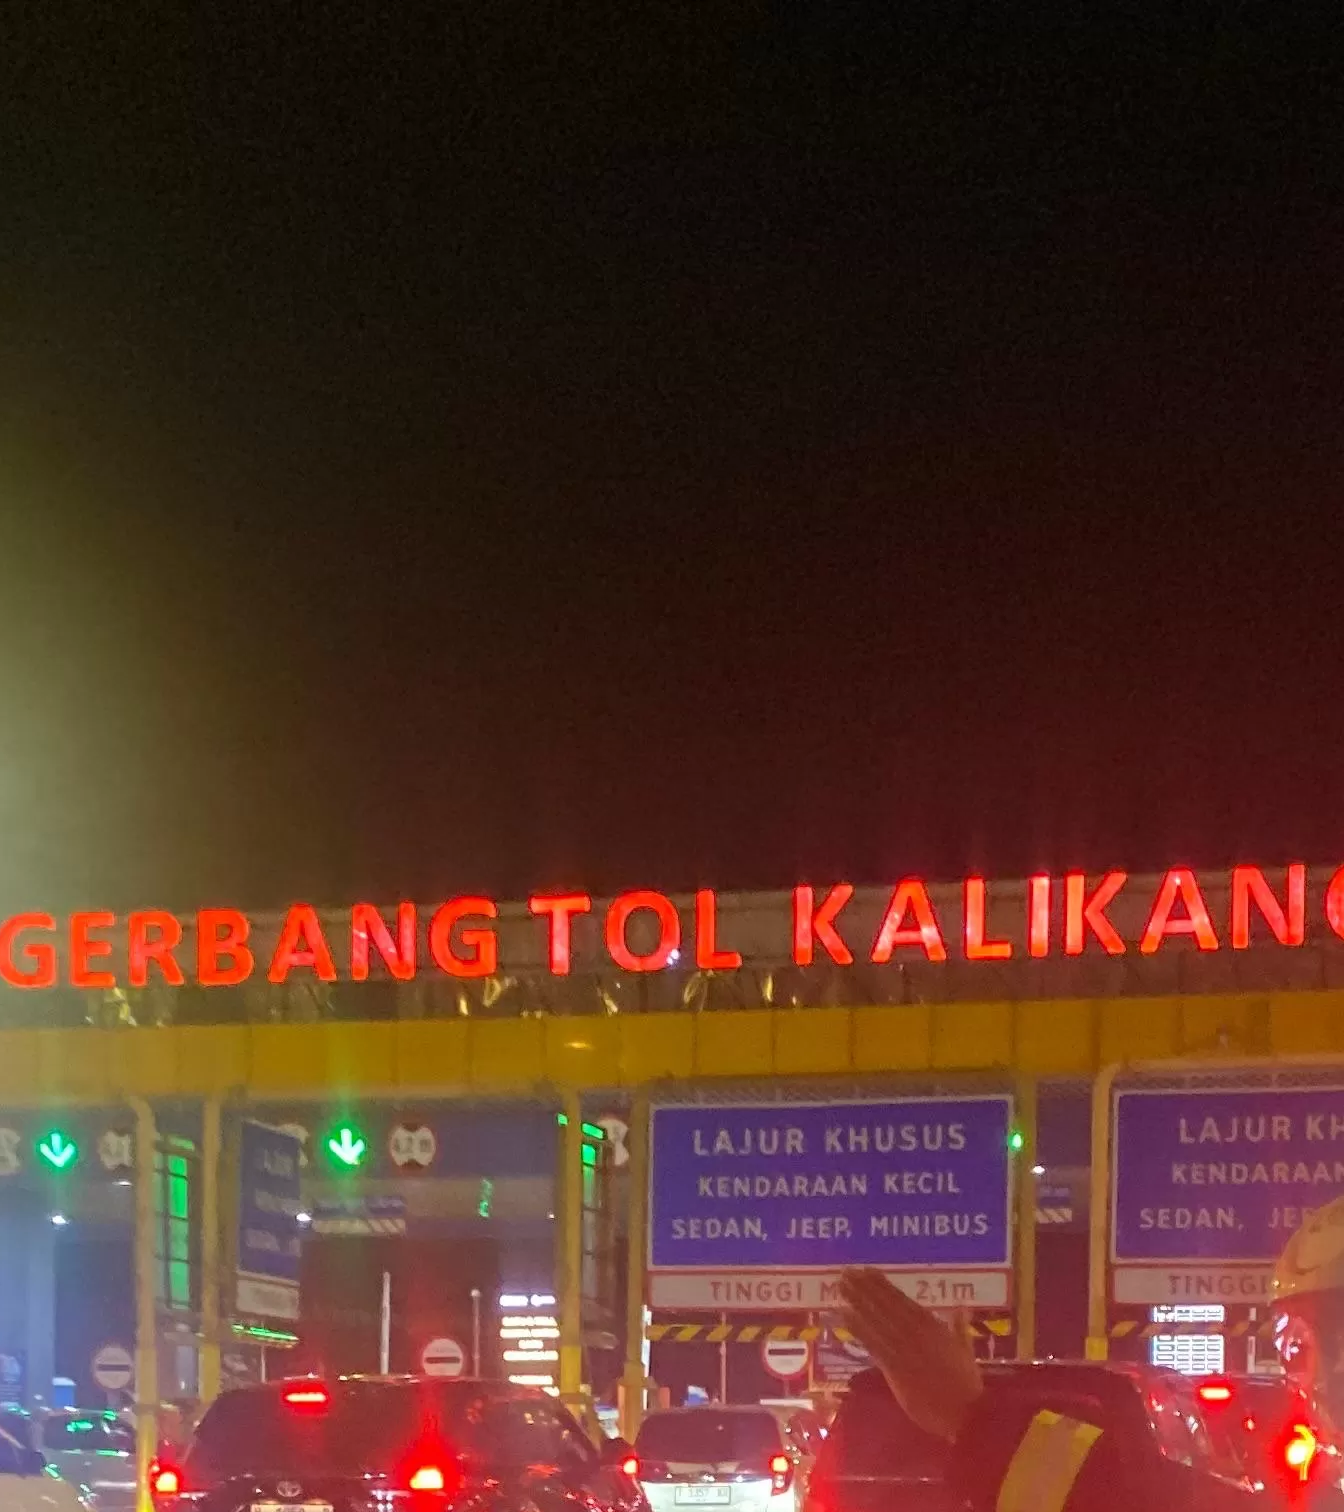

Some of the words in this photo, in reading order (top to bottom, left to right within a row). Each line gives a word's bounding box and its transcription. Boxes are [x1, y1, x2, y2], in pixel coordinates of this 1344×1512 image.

[528, 888, 741, 976] TOL
[693, 1127, 805, 1157] LAJUR
[824, 1123, 968, 1153] KHUSUS
[1179, 1115, 1292, 1145] LAJUR
[698, 1173, 868, 1198] KENDARAAN
[884, 1171, 961, 1195] KECIL
[671, 1216, 768, 1241] SEDAN,
[870, 1213, 989, 1237] MINIBUS
[1140, 1207, 1244, 1232] SEDAN,
[710, 1280, 803, 1302] TINGGI
[1168, 1274, 1269, 1297] TINGGI
